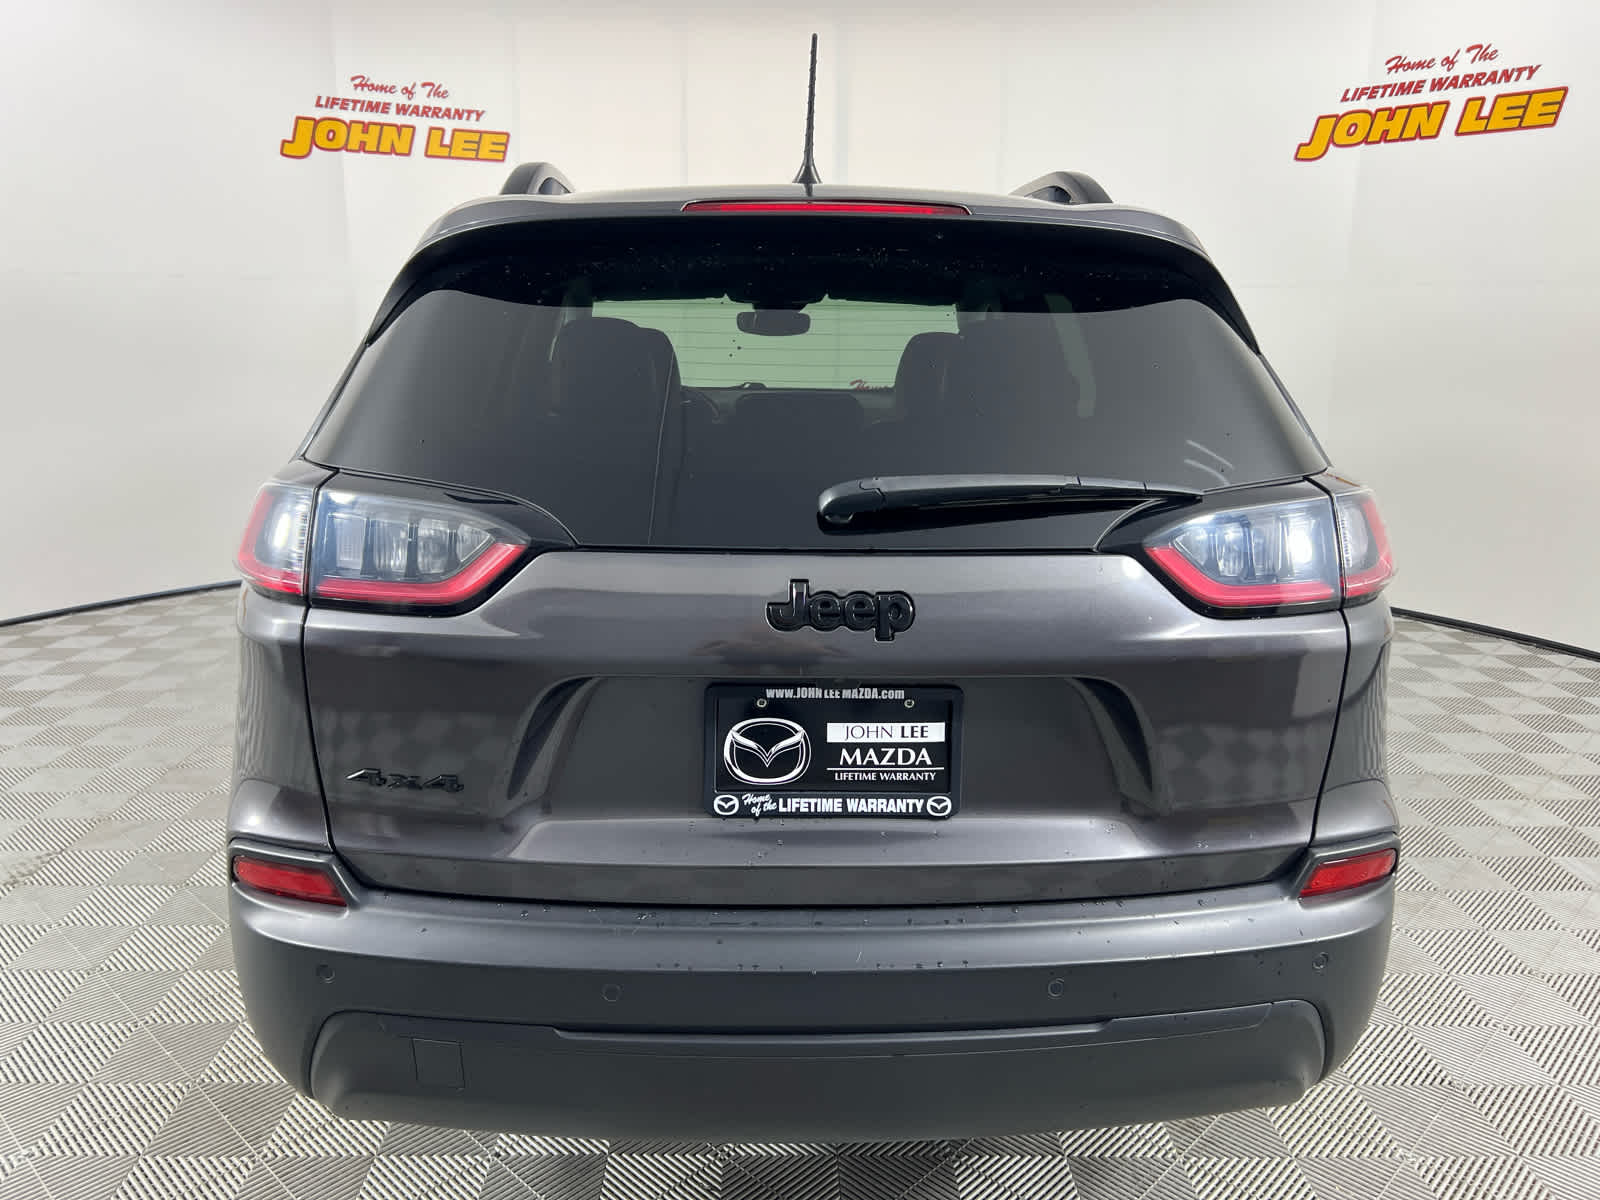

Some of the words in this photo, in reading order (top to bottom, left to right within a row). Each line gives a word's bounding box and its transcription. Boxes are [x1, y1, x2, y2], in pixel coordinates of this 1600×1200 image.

[1385, 55, 1436, 74] Home
[1441, 49, 1461, 72] of
[1466, 43, 1499, 64] The
[350, 75, 397, 95] Home
[401, 82, 417, 100] of
[421, 82, 449, 99] The
[1340, 79, 1426, 103] LIFETIME
[1429, 64, 1542, 93] WARRANTY
[315, 95, 393, 114] LIFETIME
[395, 103, 486, 122] WARRANTY
[1294, 100, 1451, 162] JOHN
[1455, 86, 1569, 136] LEE
[280, 115, 416, 159] JOHN
[424, 126, 511, 162] LEE
[765, 578, 916, 642] Jeep
[844, 725, 894, 740] JOHN
[900, 725, 929, 739] LEE
[839, 747, 933, 766] MAZDA
[834, 772, 878, 781] LIFETIME
[880, 772, 936, 781] WARRANTY
[742, 793, 771, 805] Home
[751, 804, 762, 817] of
[762, 801, 777, 812] the
[778, 797, 846, 813] LIFETIME
[847, 798, 925, 814] WARRANTY
